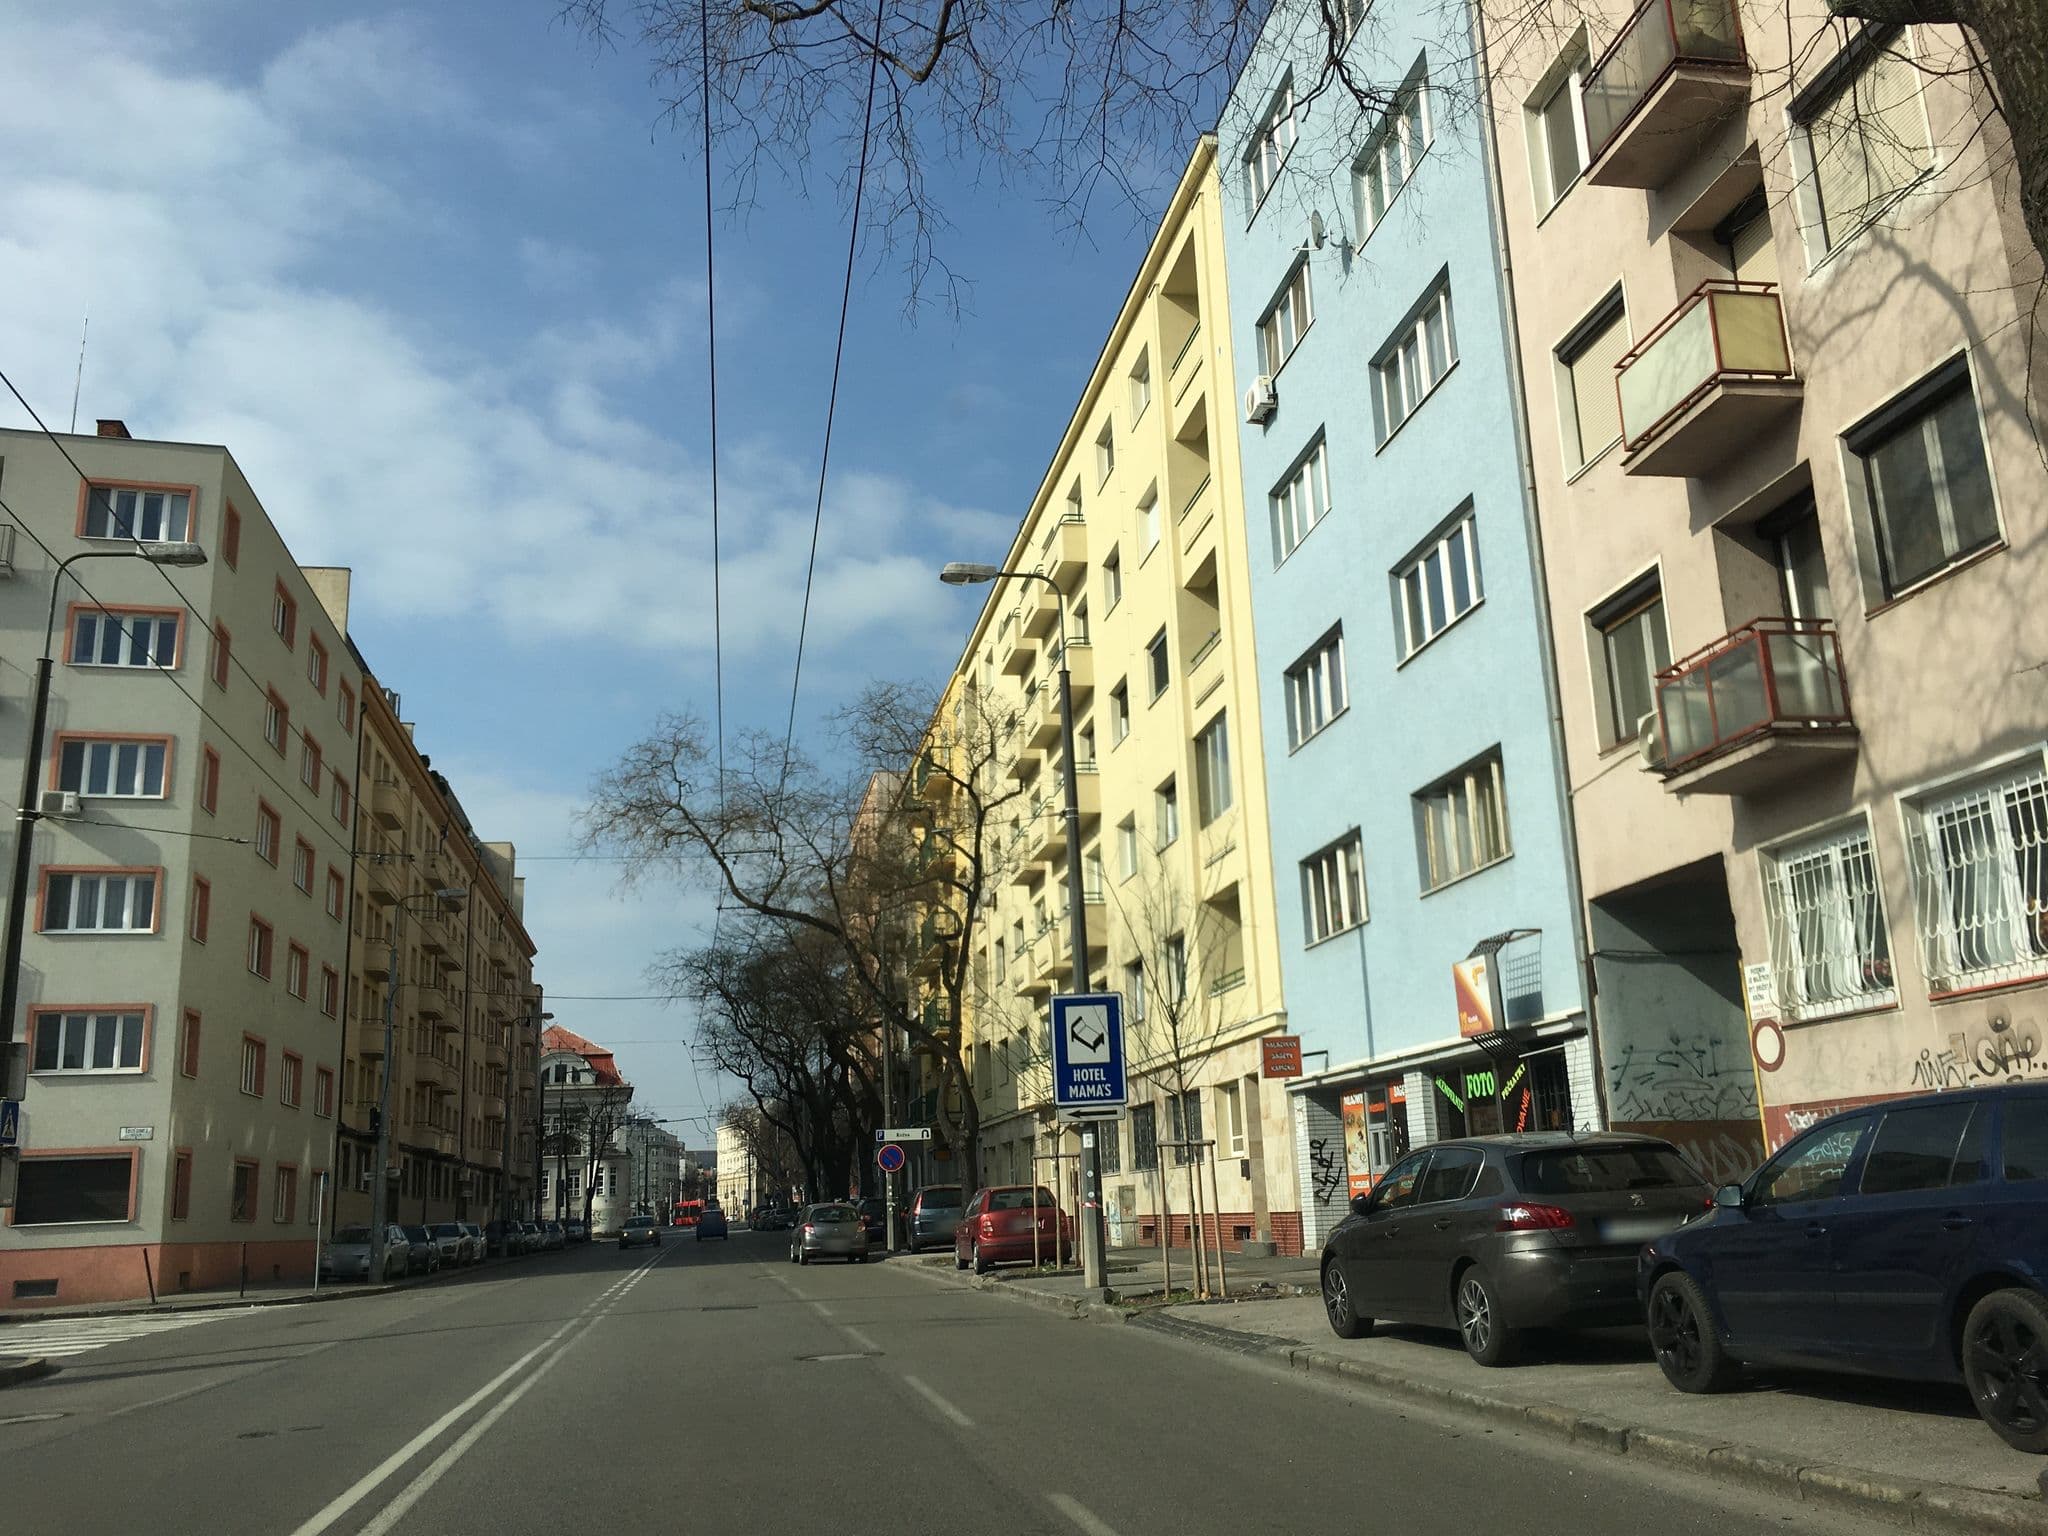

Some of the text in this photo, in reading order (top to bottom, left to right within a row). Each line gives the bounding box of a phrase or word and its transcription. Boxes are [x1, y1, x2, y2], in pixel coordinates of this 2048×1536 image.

[1073, 1068, 1107, 1082] HOTEL
[1069, 1083, 1112, 1098] MAMA'S
[1466, 1071, 1495, 1099] FOTO
